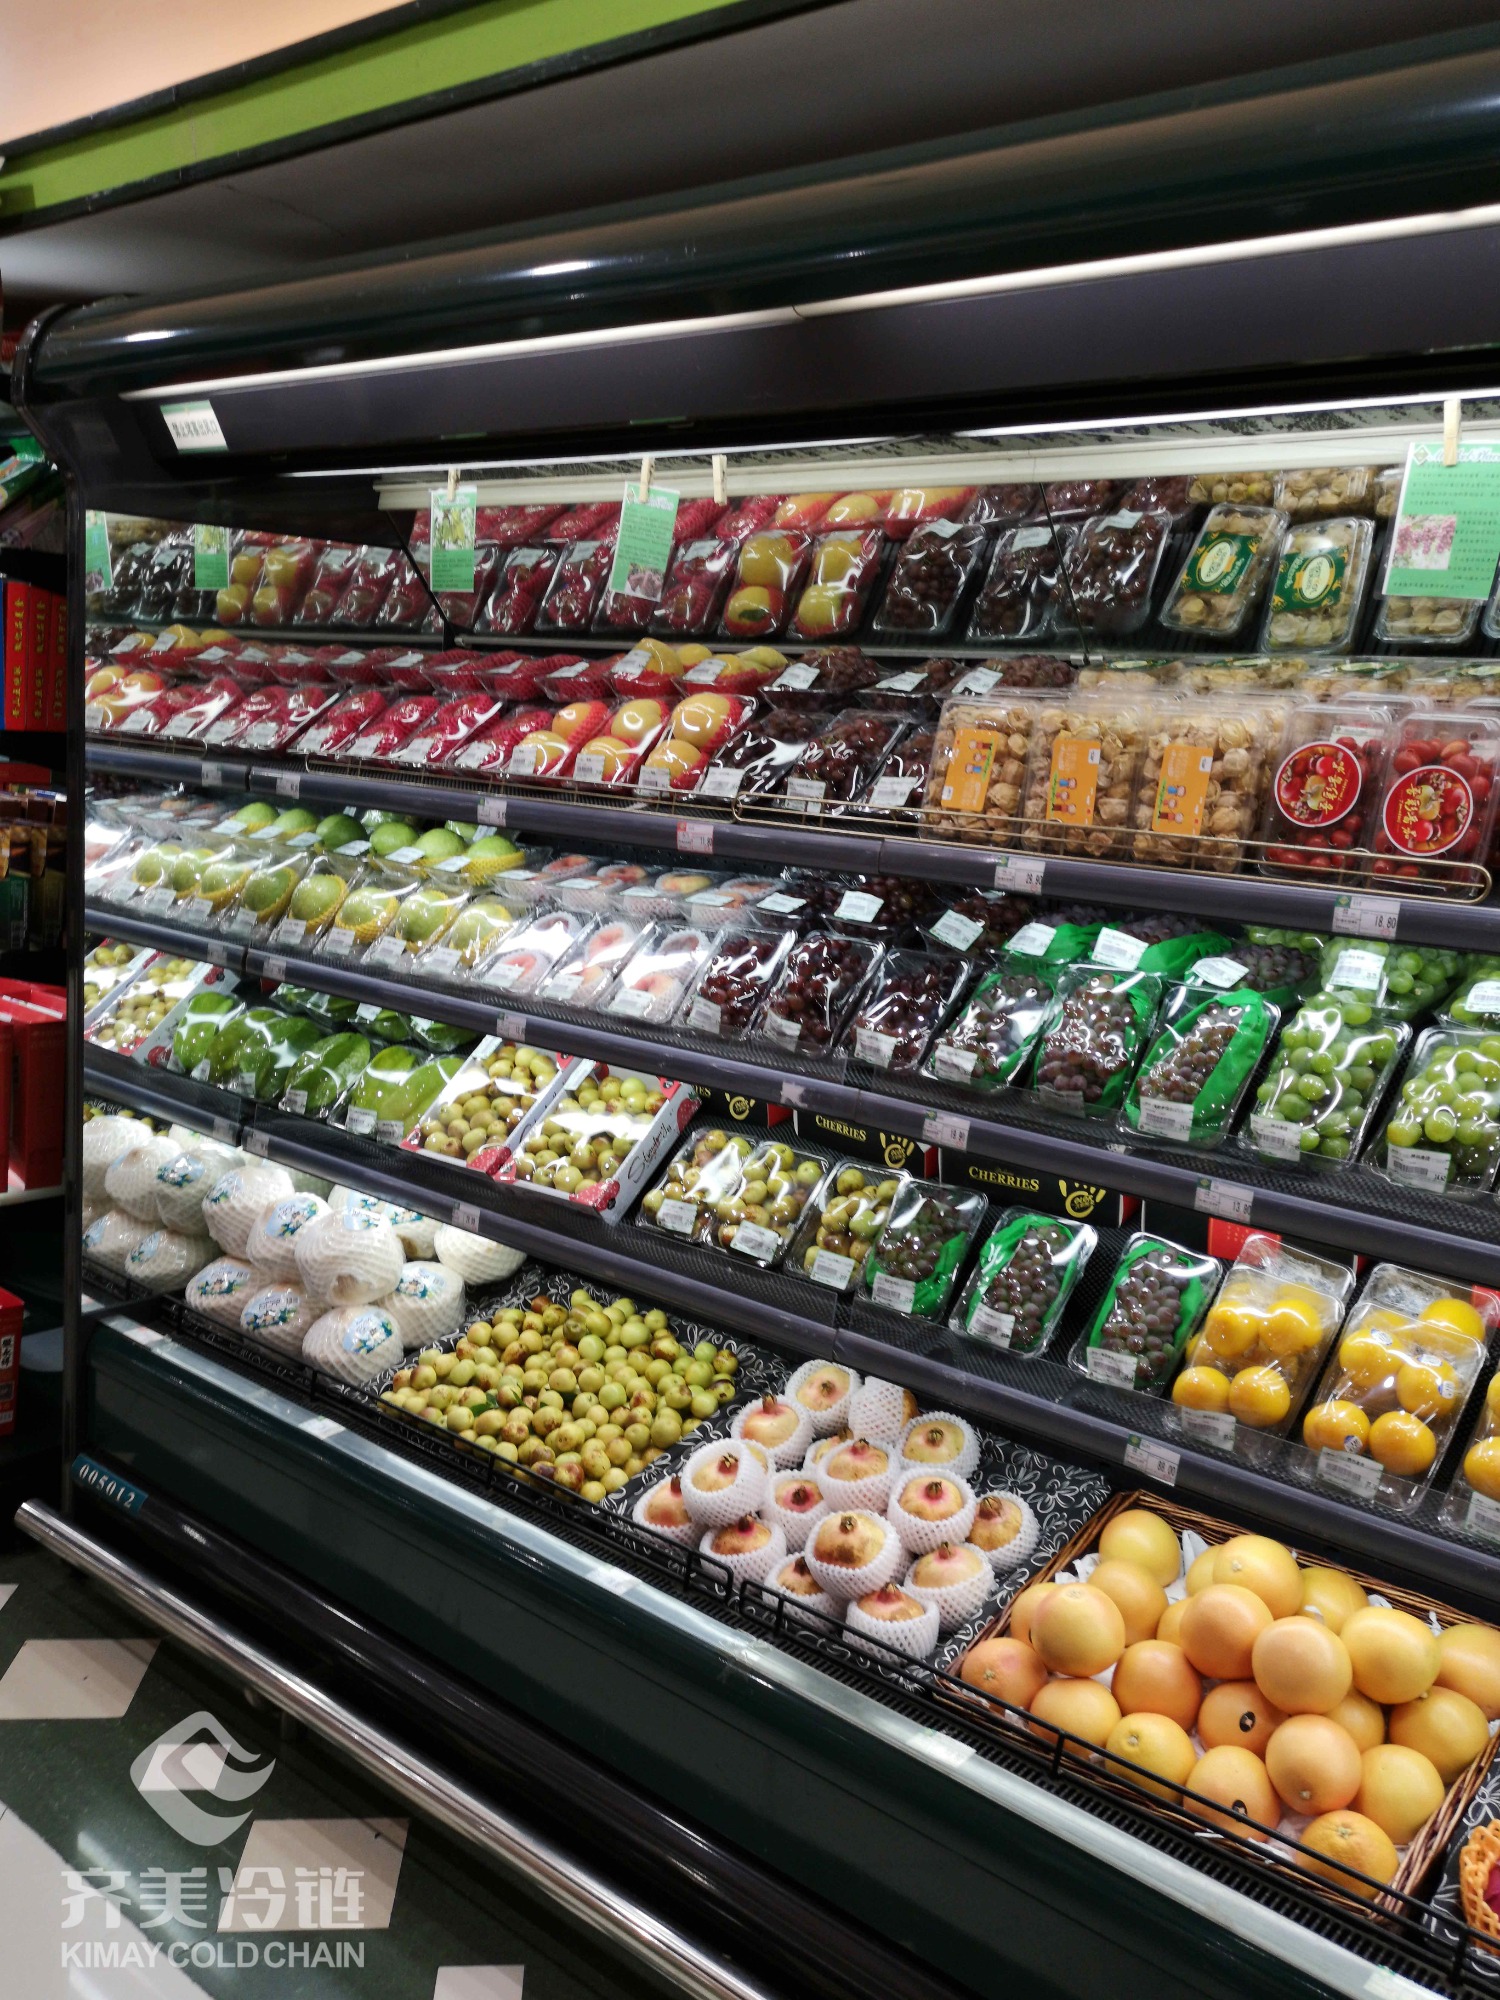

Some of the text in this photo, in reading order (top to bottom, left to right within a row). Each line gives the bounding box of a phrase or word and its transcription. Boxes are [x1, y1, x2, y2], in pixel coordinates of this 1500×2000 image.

[815, 1114, 867, 1142] CHERRIES
[968, 1165, 1040, 1193] CHERRIES
[78, 1463, 136, 1509] 005012
